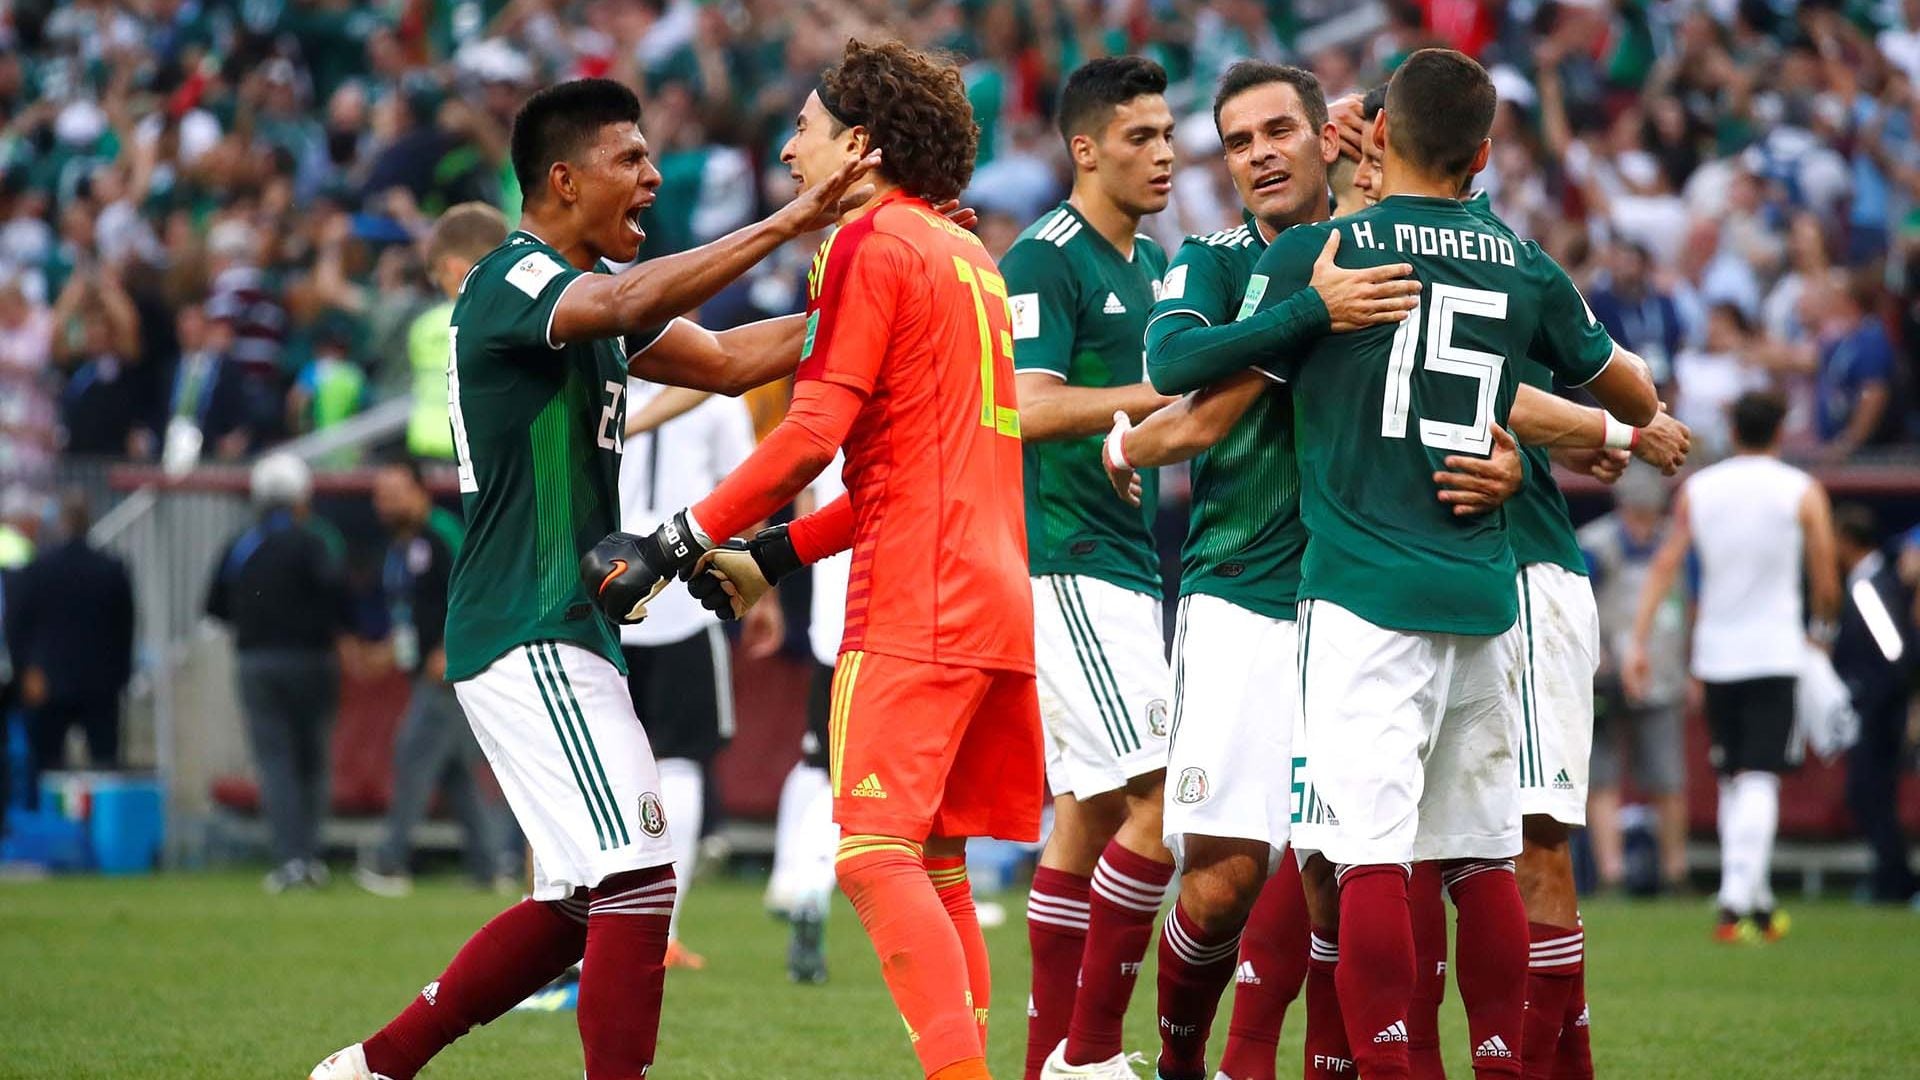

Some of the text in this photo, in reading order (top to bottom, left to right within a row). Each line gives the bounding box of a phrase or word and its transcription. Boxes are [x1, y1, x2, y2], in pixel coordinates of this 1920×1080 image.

[1352, 221, 1516, 267] H. MORENO
[1381, 282, 1508, 456] 15
[597, 380, 624, 454] 2
[851, 788, 888, 799] adidas
[1373, 1033, 1409, 1044] adida
[1476, 1048, 1512, 1059] adidas
[1314, 1054, 1353, 1074] FMF
